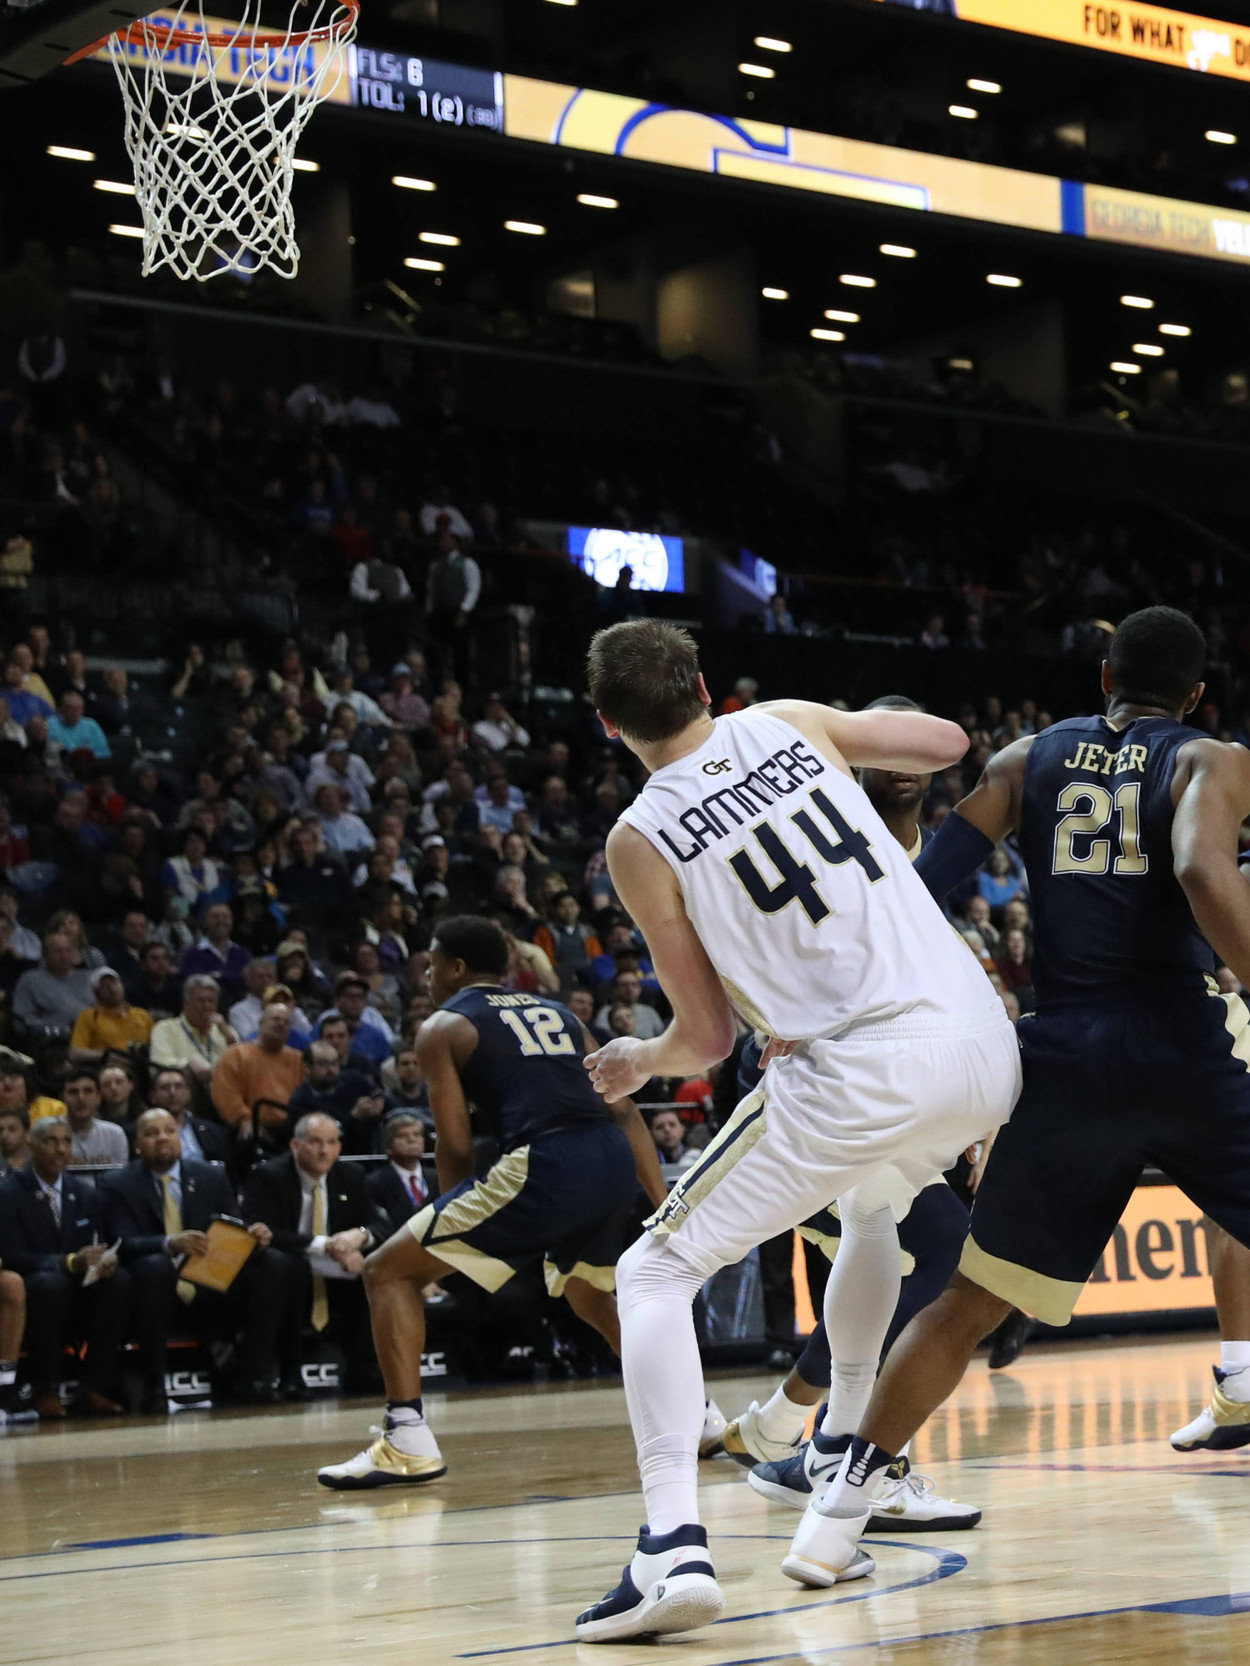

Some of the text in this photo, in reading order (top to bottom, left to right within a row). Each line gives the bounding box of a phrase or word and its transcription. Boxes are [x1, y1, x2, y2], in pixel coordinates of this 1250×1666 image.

[1084, 5, 1121, 40] FOR
[1129, 16, 1185, 53] WHAT
[358, 47, 423, 87] FLS: 6
[358, 77, 405, 112] TOL:
[1064, 741, 1149, 776] JETER
[657, 740, 825, 863] LAMMERS
[1052, 781, 1149, 875] 21
[725, 784, 888, 929] 44
[499, 1006, 576, 1057] 12
[1089, 1214, 1214, 1284] nen
[300, 1363, 339, 1387] CC
